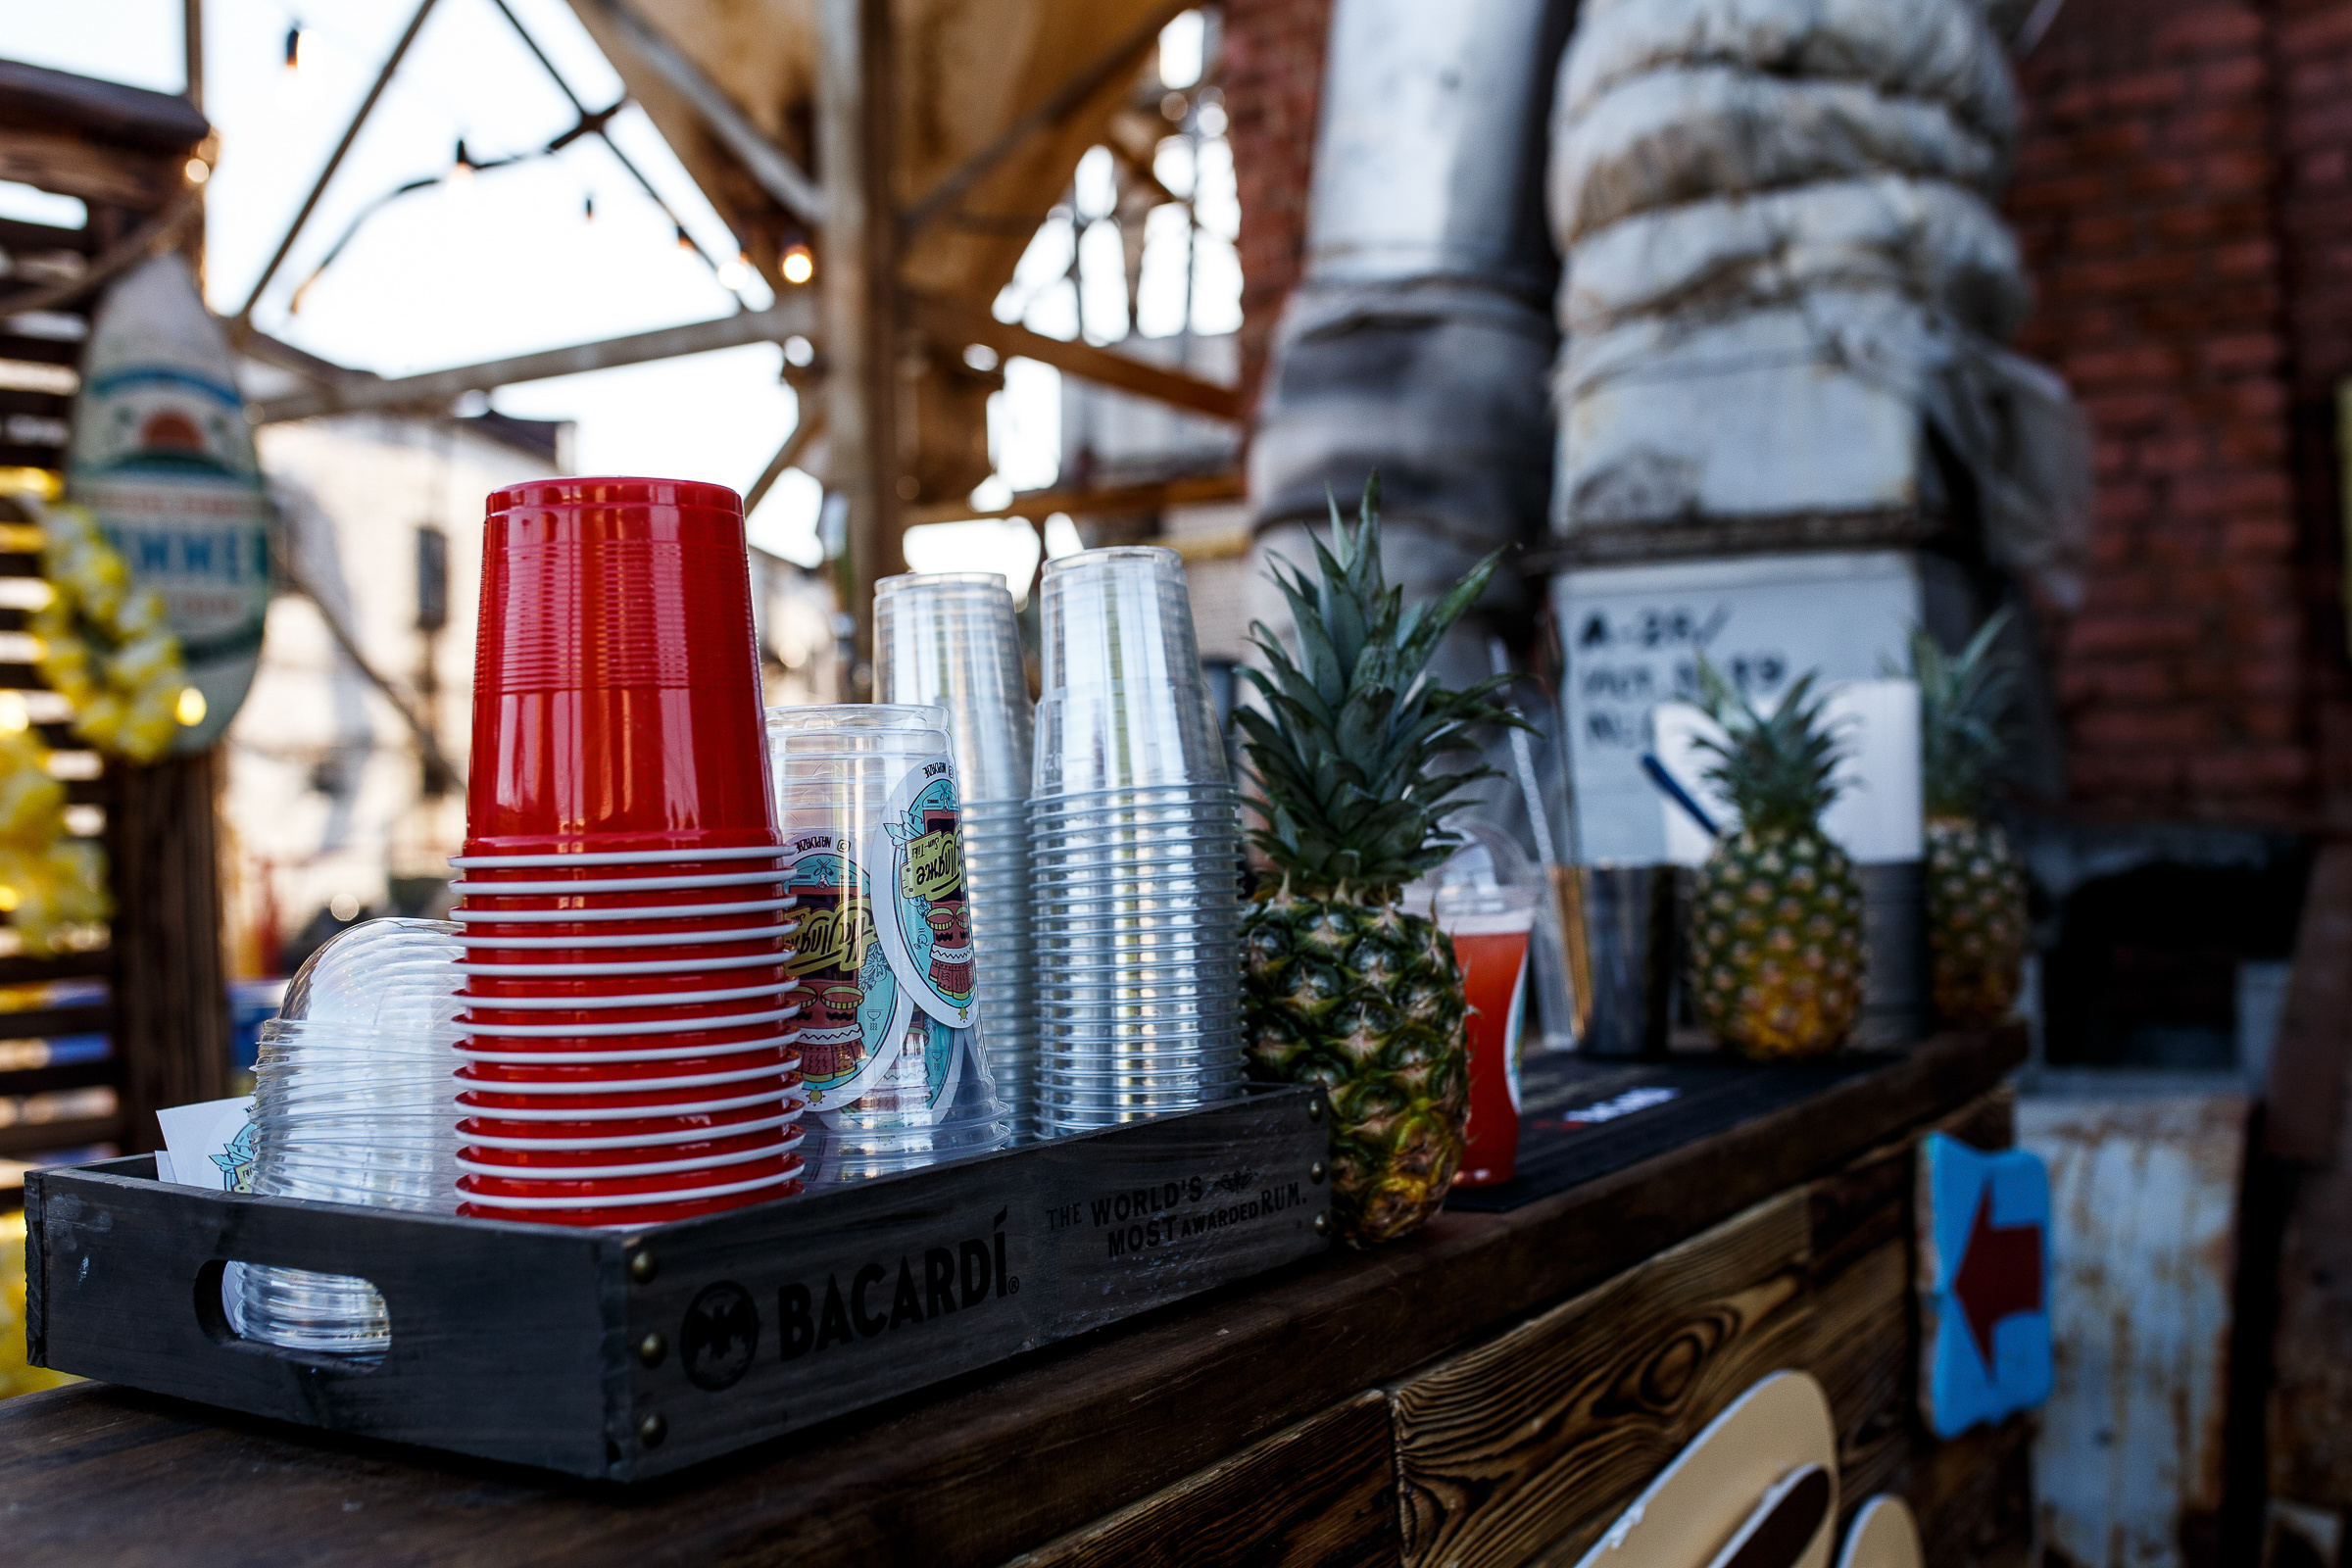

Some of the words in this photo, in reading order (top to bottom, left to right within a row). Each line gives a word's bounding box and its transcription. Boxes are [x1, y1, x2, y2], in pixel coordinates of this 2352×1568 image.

[1046, 1202, 1082, 1230] THE
[1091, 1176, 1203, 1227] WORLD'S
[1107, 1215, 1176, 1257] MOST
[1181, 1200, 1258, 1238] AWARDED
[1260, 1182, 1307, 1216] RUM.
